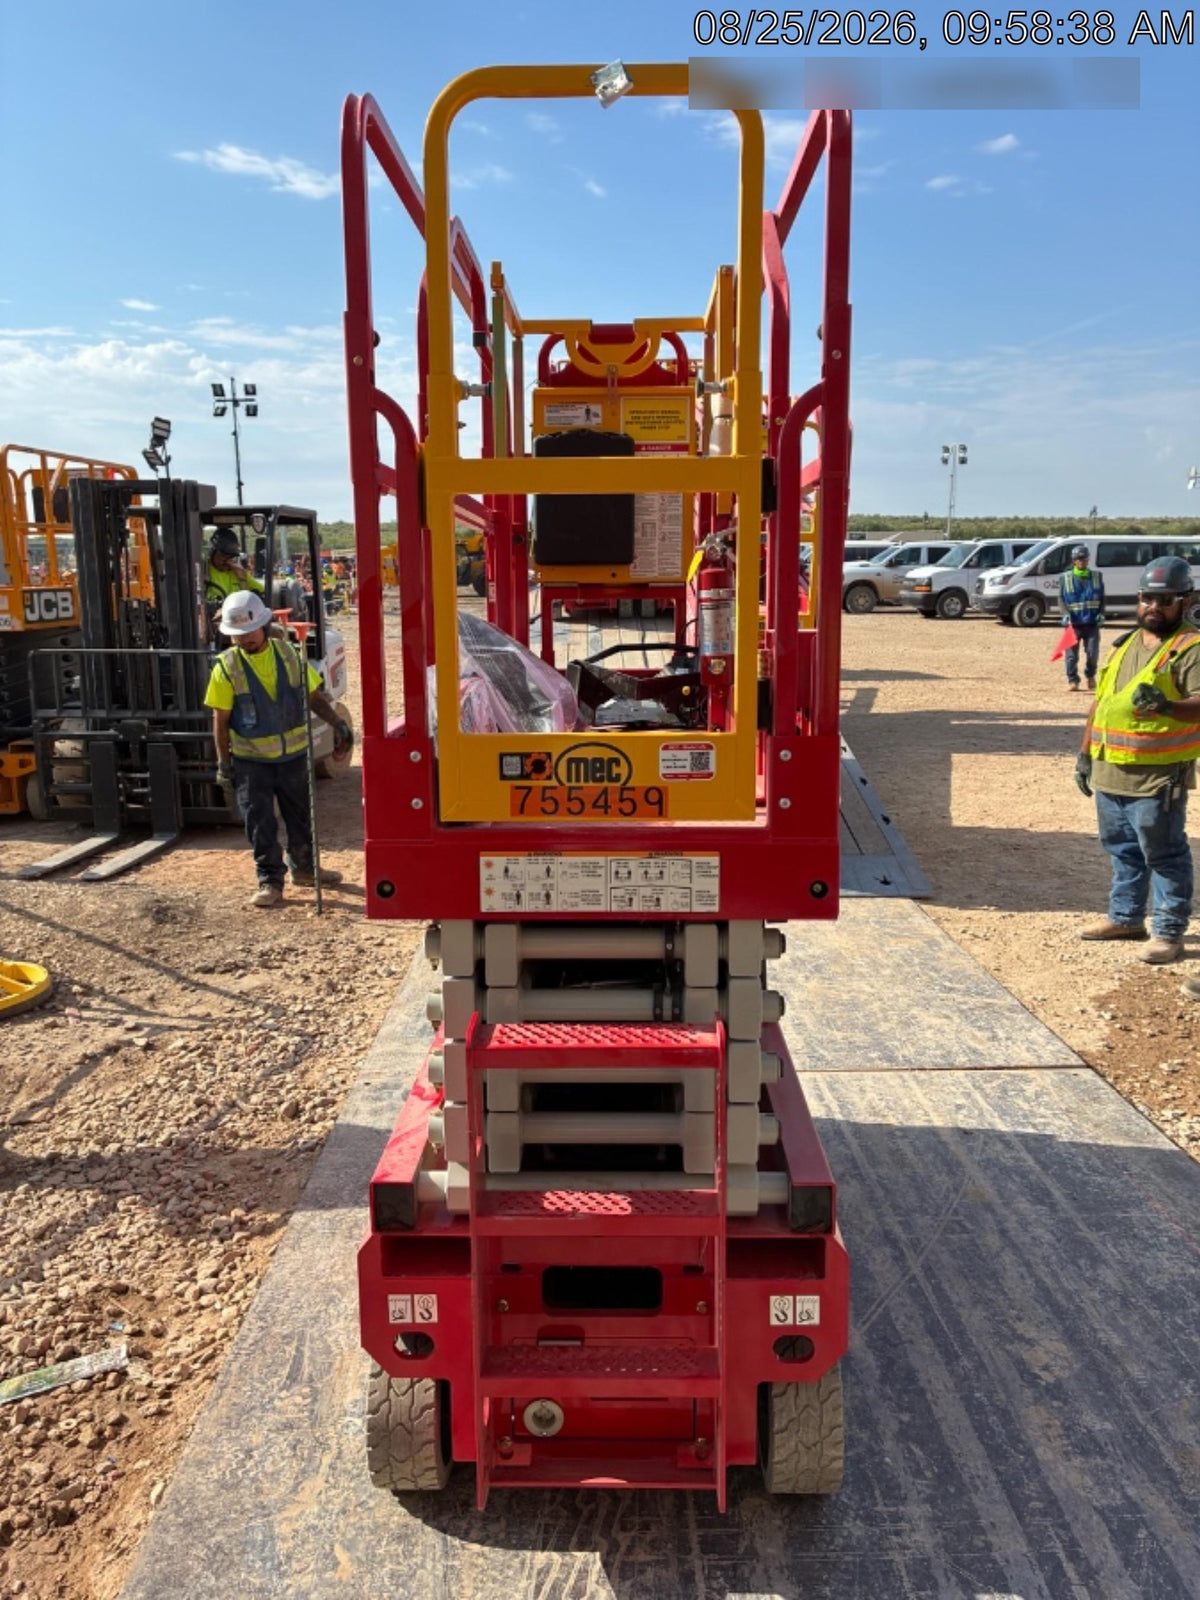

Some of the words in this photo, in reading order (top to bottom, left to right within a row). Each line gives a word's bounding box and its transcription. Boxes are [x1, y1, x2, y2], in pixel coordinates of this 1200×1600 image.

[25, 591, 74, 621] JCB
[566, 757, 622, 783] mec
[514, 786, 664, 816] 755459
